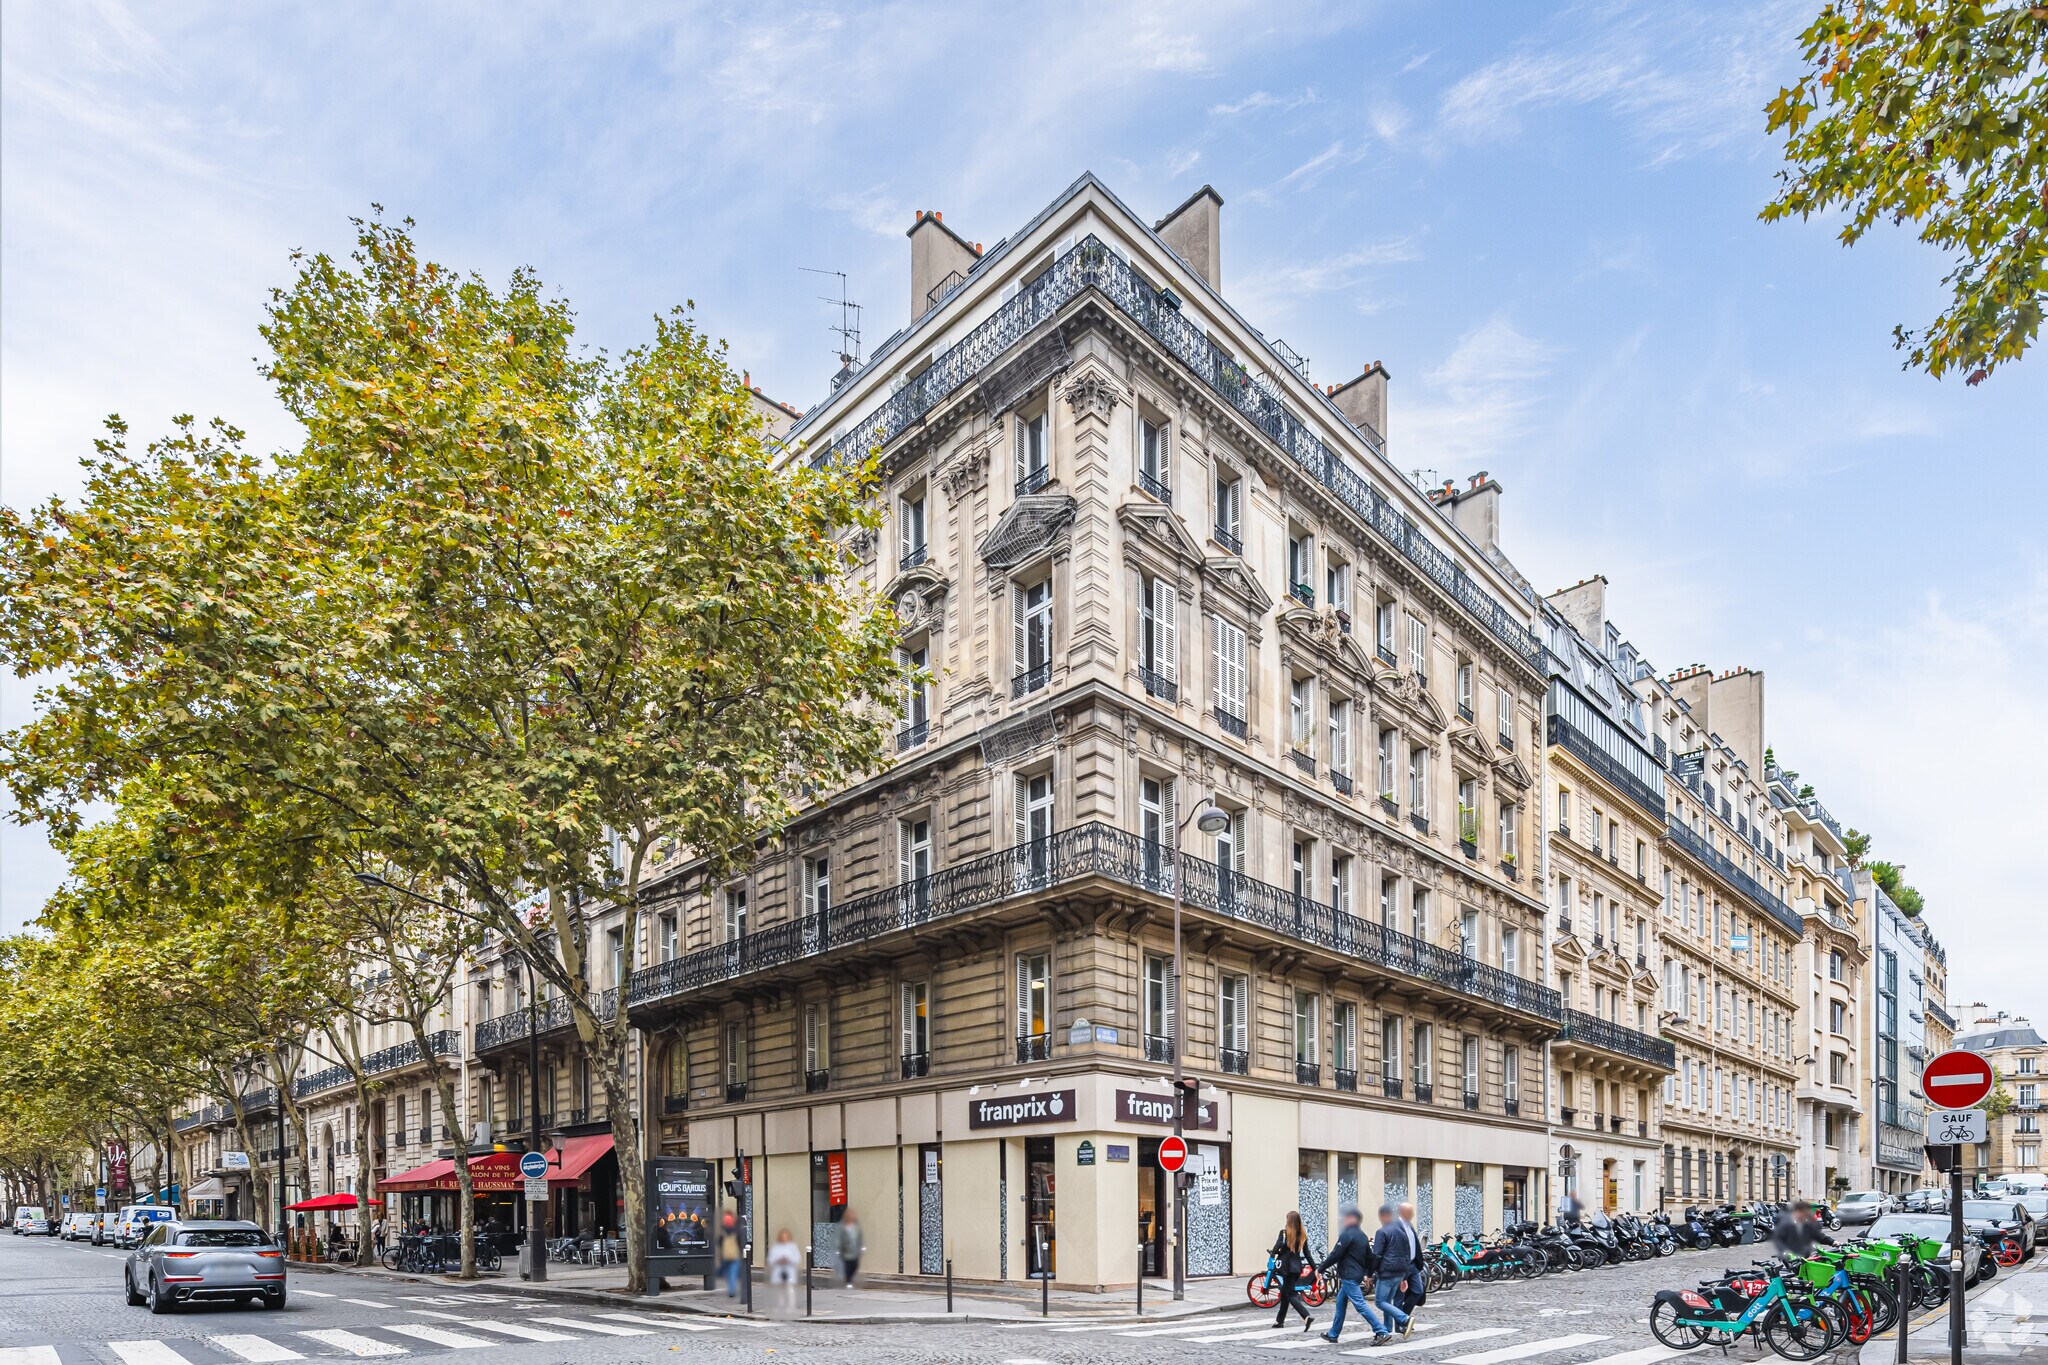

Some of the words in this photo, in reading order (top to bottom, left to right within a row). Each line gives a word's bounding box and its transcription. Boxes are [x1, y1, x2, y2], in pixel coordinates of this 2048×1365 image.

[979, 1096, 1047, 1123] franprix
[1942, 1113, 1973, 1123] SAUF
[814, 1155, 824, 1163] 144
[1201, 1176, 1212, 1184] Prix
[682, 1184, 707, 1194] GAROUS
[1201, 1184, 1219, 1192] baisse
[1747, 1302, 1763, 1318] dott
